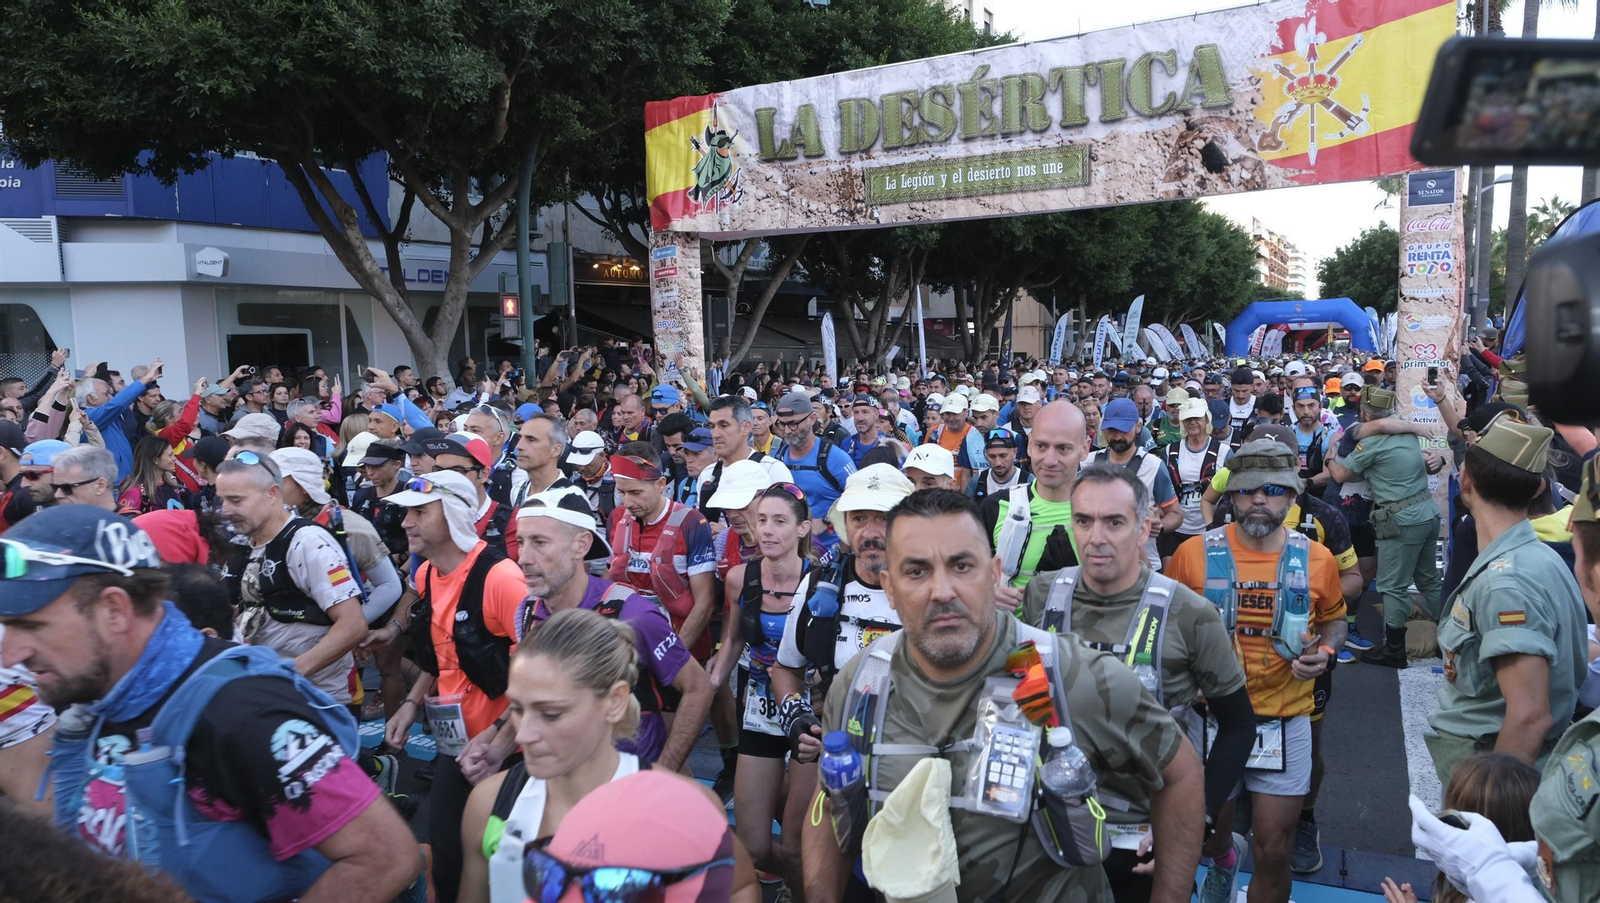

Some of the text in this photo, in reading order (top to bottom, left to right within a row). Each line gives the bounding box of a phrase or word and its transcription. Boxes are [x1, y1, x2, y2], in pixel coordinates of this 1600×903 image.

[755, 43, 1235, 161] LA DESÉRTICA
[884, 160, 1065, 191] La Legión y el desierto nos une
[1408, 243, 1451, 251] GRUPO
[1408, 251, 1452, 262] RENTA
[1408, 262, 1452, 275] TODO
[657, 321, 678, 329] BBVA
